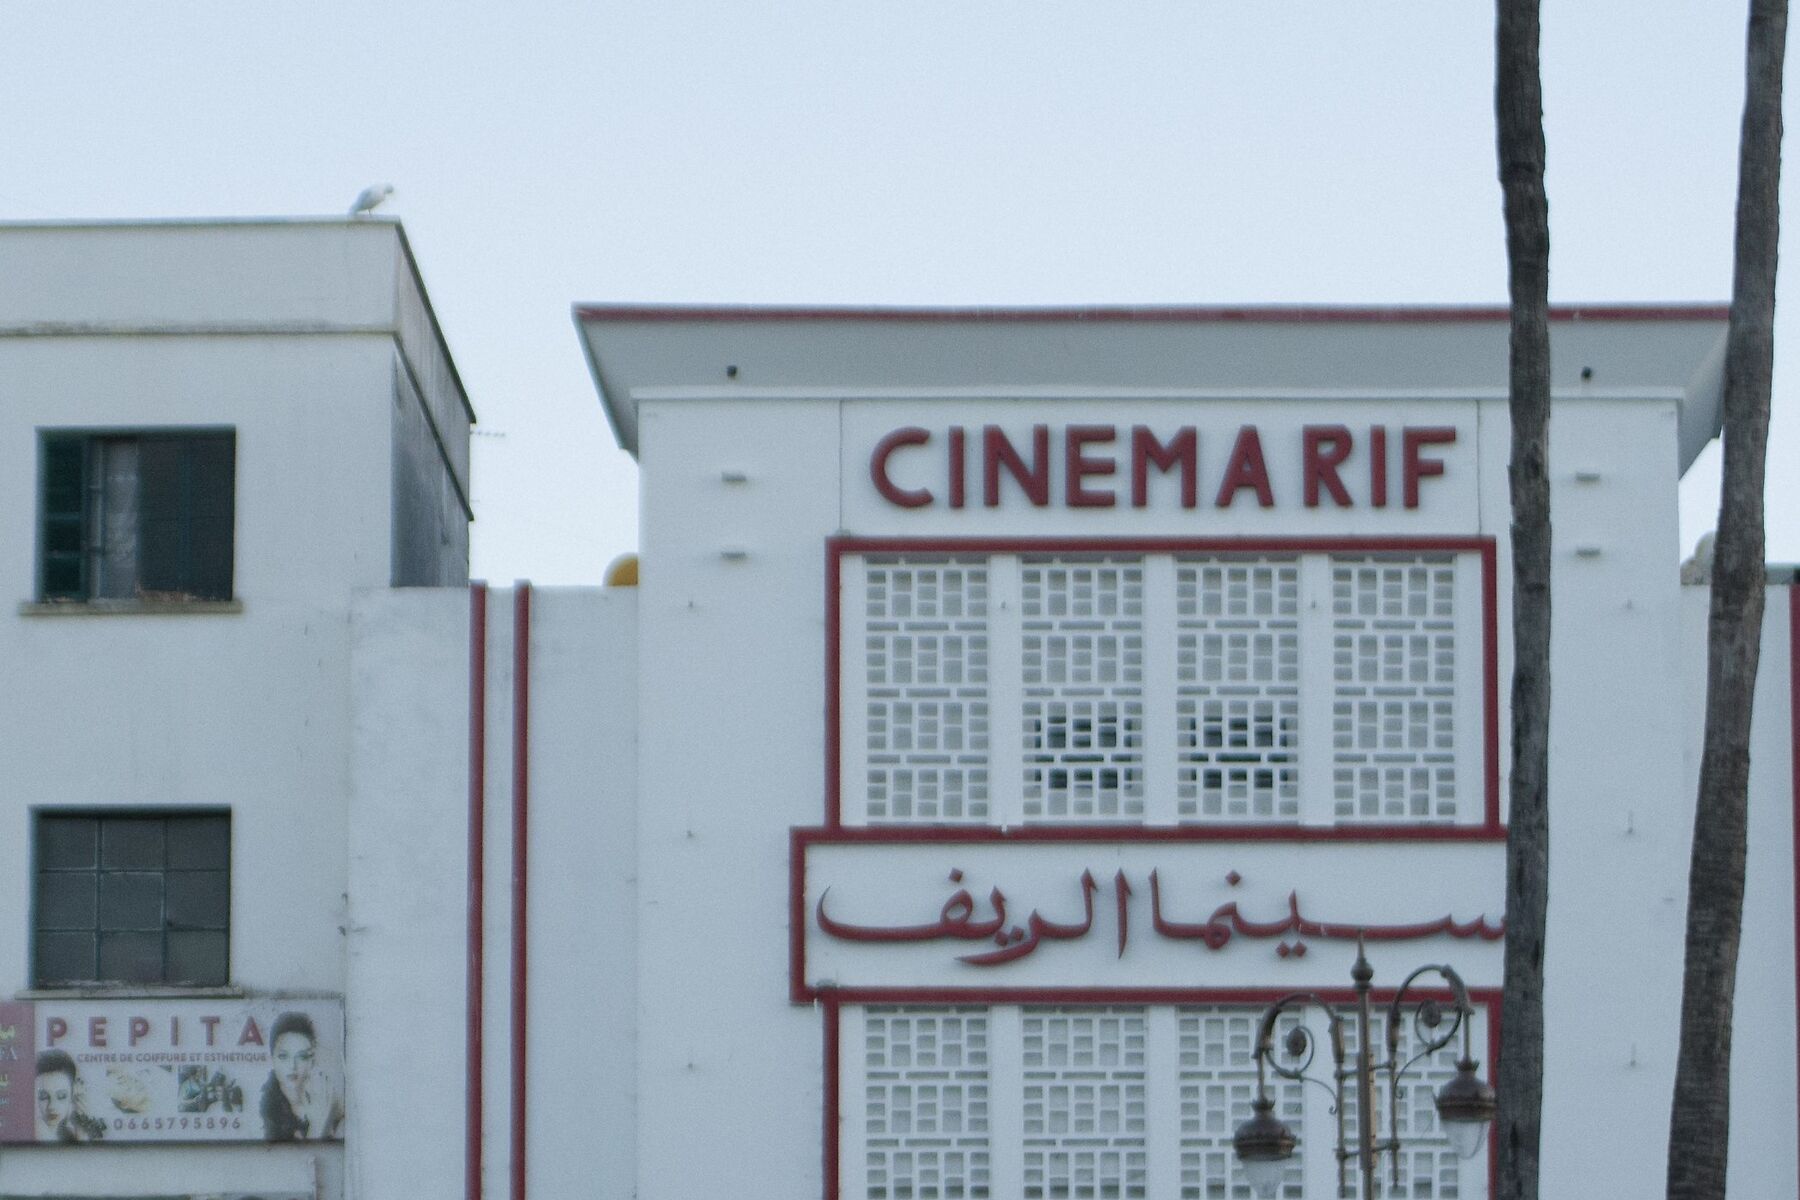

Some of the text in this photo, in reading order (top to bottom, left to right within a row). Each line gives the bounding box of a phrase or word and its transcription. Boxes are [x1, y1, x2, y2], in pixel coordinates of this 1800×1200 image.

[45, 1015, 265, 1048] PEPITA
[77, 1053, 116, 1063] CENTRE
[119, 1053, 133, 1063] DE
[135, 1052, 187, 1063] COIFFURE
[189, 1053, 202, 1063] ET
[113, 1117, 242, 1131] 0665795896
